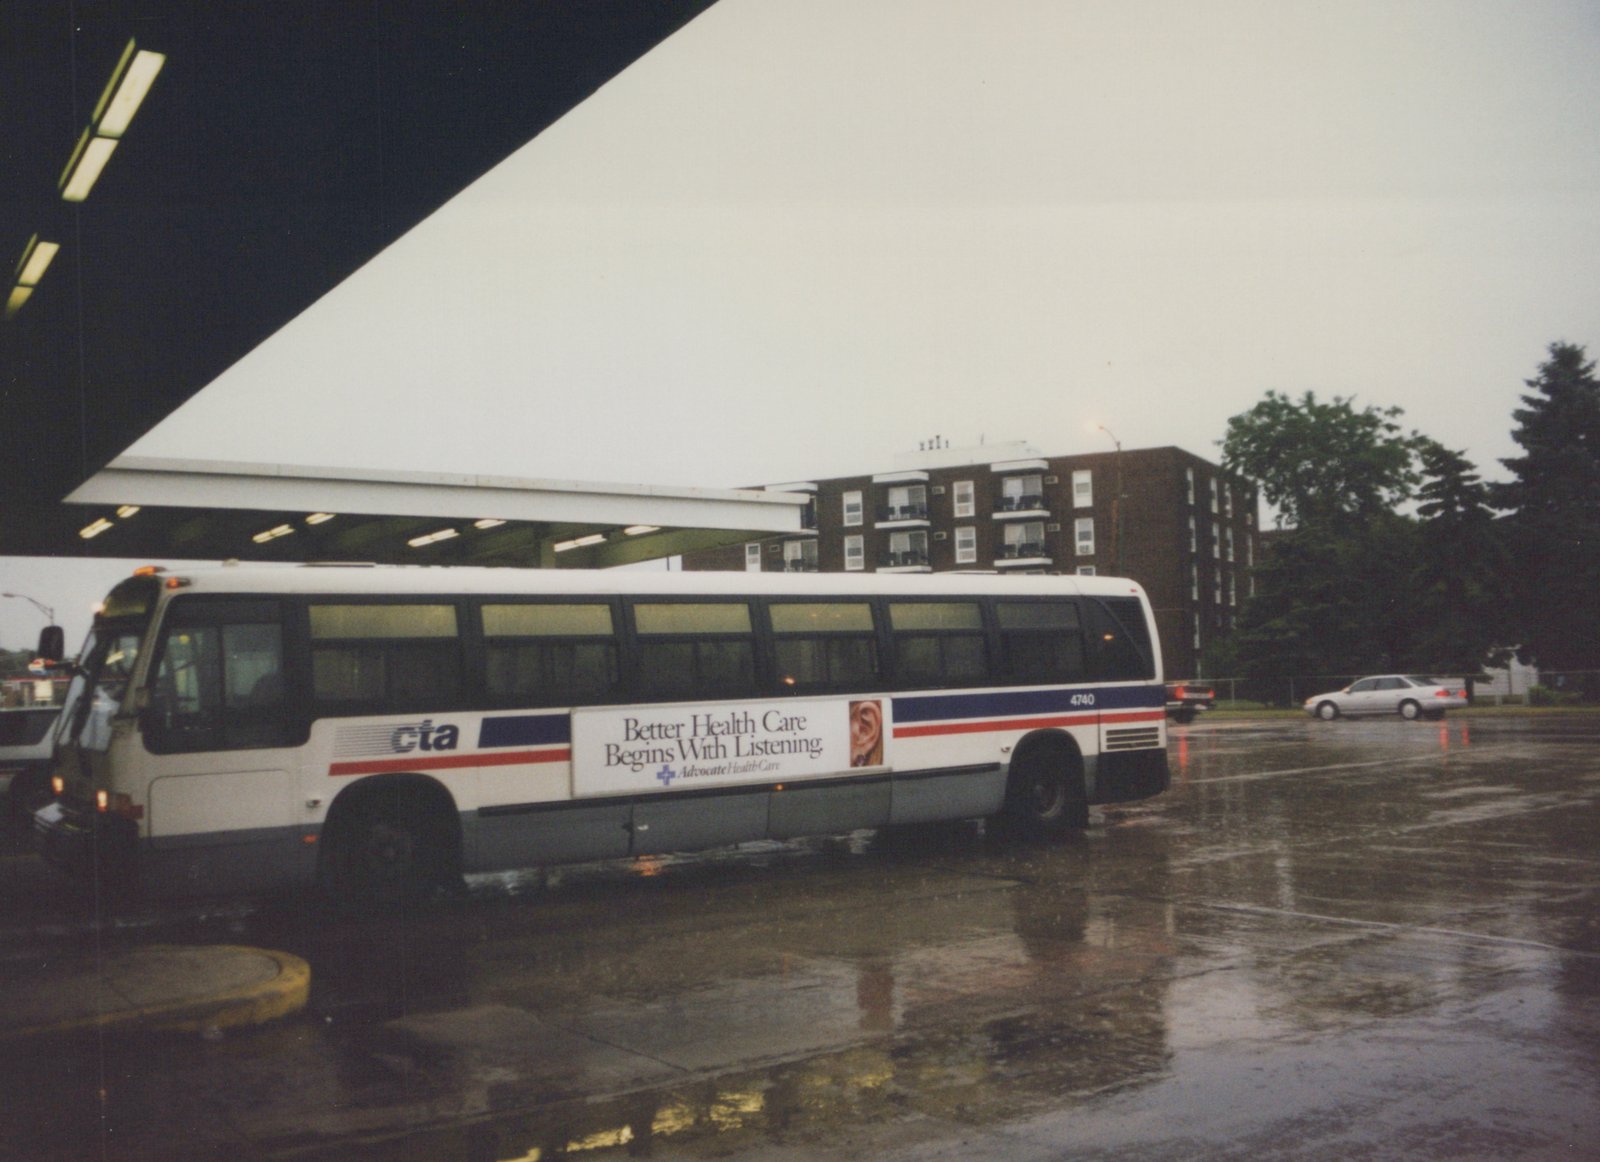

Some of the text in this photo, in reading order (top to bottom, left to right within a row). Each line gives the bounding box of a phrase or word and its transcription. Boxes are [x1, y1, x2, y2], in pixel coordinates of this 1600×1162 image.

[1070, 694, 1095, 706] 4740
[391, 719, 460, 753] cta
[623, 709, 807, 742] Better Health Care
[605, 742, 675, 772] Begins
[677, 735, 728, 761] With
